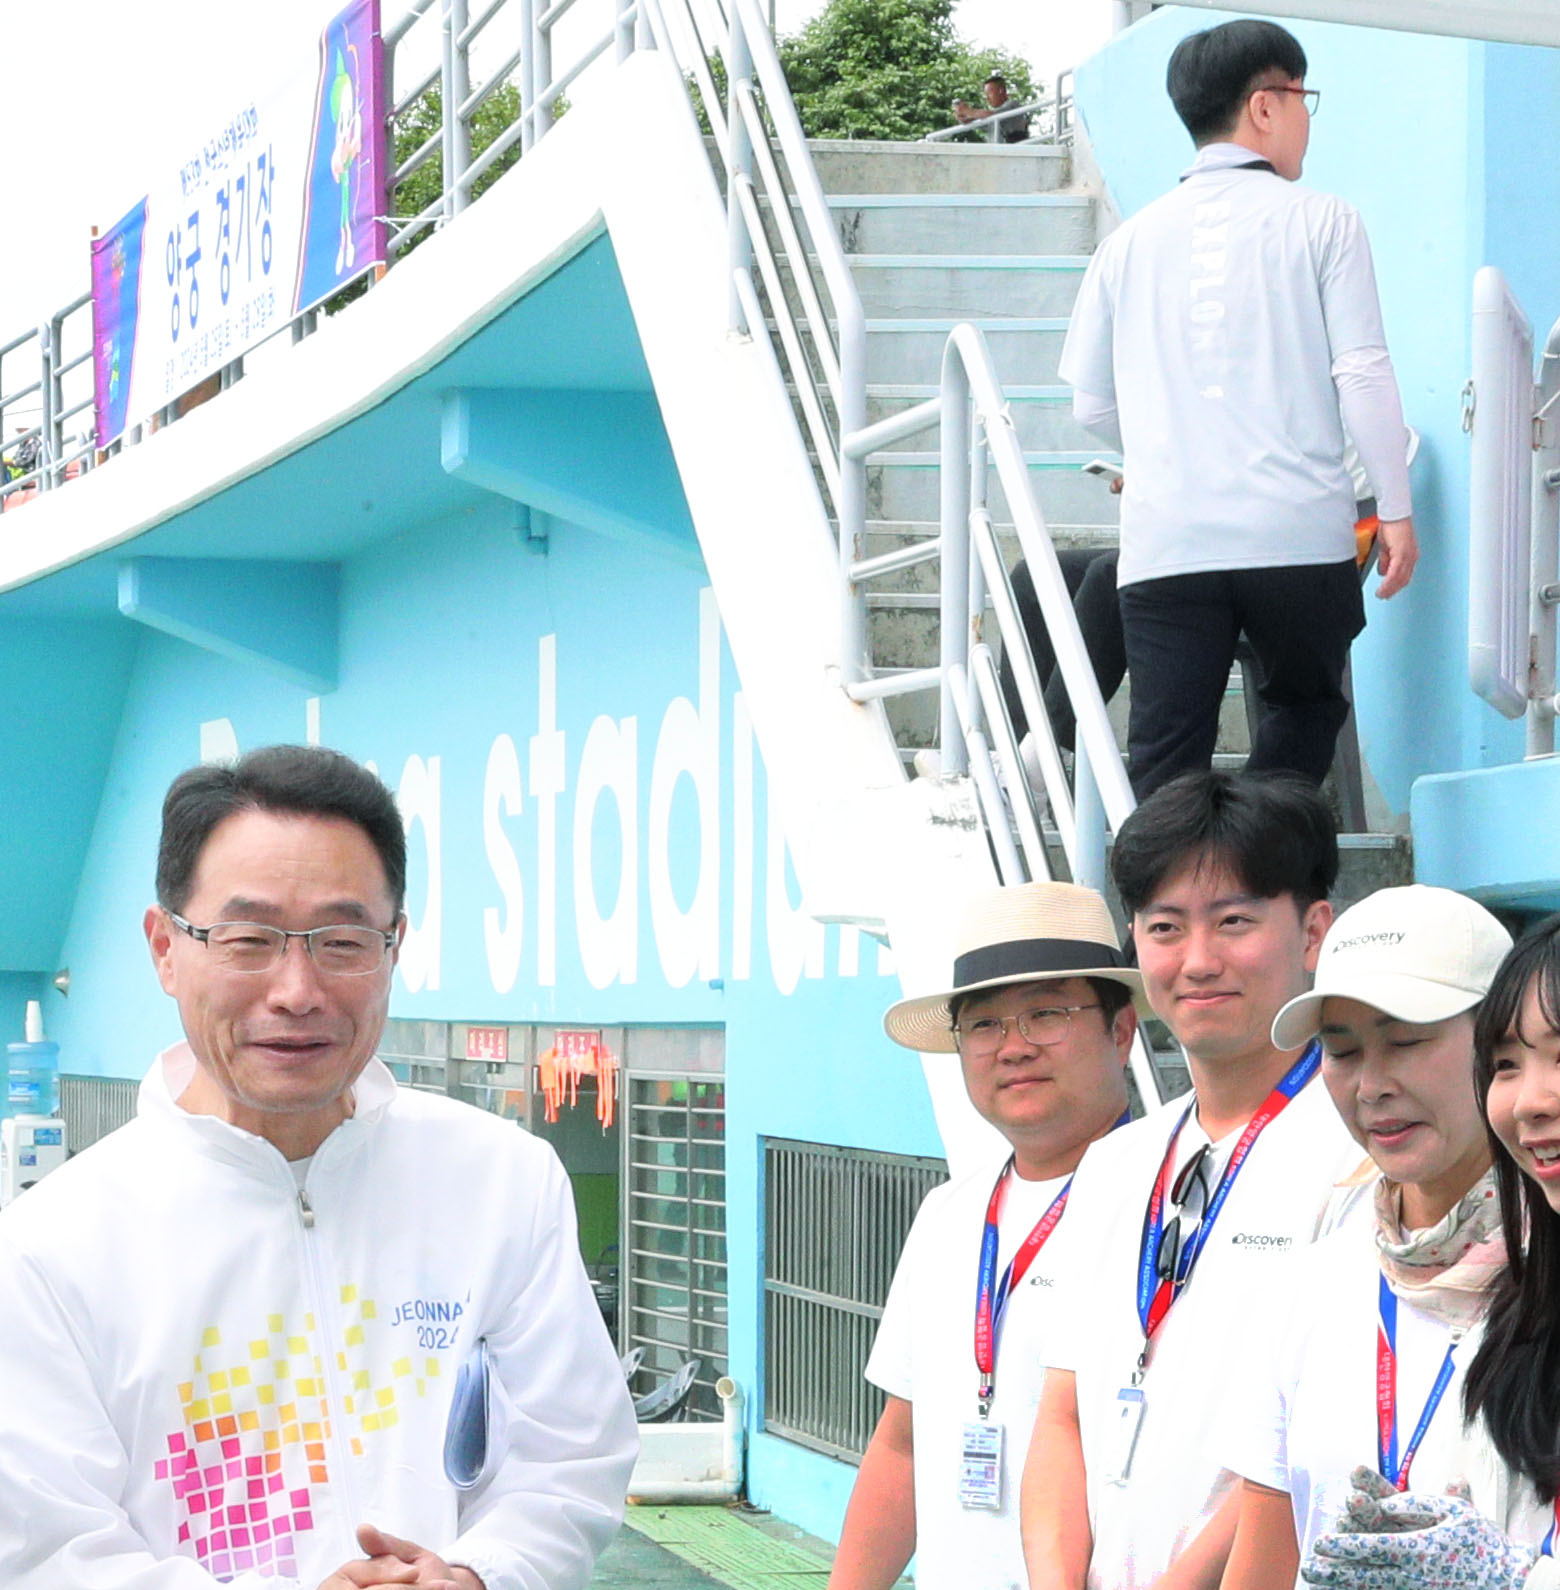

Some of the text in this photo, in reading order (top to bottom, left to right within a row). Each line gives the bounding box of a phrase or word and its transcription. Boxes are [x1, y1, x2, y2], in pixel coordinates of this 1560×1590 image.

[166, 209, 202, 343] 양궁
[216, 143, 275, 306] 경기장
[1189, 199, 1233, 358] EXPLOR
[483, 586, 896, 996] stadi
[391, 1287, 471, 1326] JEONNA
